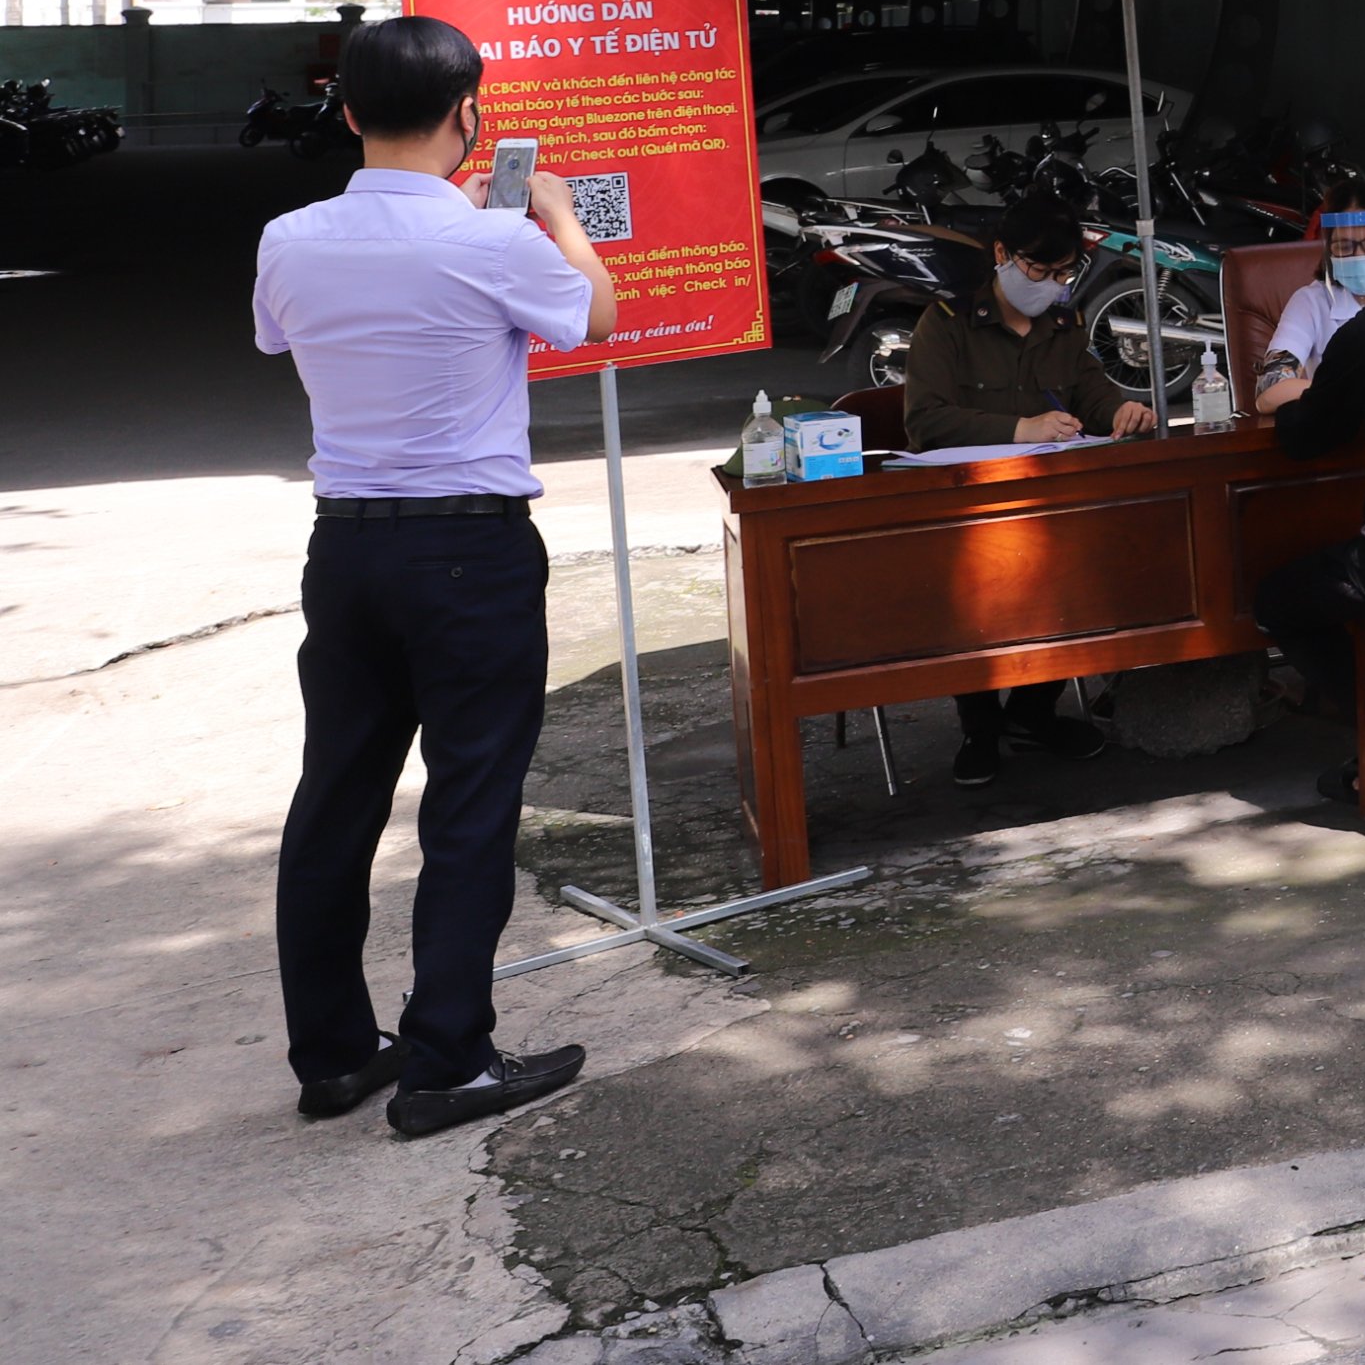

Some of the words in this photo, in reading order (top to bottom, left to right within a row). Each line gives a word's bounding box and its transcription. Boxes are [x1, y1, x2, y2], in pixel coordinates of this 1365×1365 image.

[507, 0, 595, 26] HƯỚNG
[510, 35, 562, 60] BÁO
[567, 37, 585, 56] Y
[591, 27, 622, 55] TẾ
[625, 29, 680, 57] ĐIỆN
[685, 23, 718, 49] TỬ
[490, 80, 541, 95] CBCNV
[543, 79, 561, 92] và
[563, 75, 606, 91] khách
[607, 72, 634, 87] đến
[636, 72, 659, 85] liên
[661, 71, 678, 85] hệ
[679, 69, 714, 83] công
[715, 67, 737, 80] tác
[493, 100, 524, 114] khai
[526, 97, 554, 111] báo
[555, 99, 564, 111] y
[565, 94, 580, 108] tế
[581, 94, 612, 107] theo
[613, 91, 641, 105] các
[642, 89, 676, 103] bước
[677, 89, 705, 101] sau:
[484, 120, 496, 132] 1:
[497, 116, 520, 131] Mở
[521, 114, 548, 131] ứng
[549, 114, 585, 128] dụng
[586, 111, 646, 125] Bluezone
[647, 107, 672, 121] trên
[673, 105, 702, 119] điện
[702, 102, 738, 117] thoại.
[539, 133, 564, 148] tiện
[566, 131, 591, 144] ích,
[593, 131, 617, 143] sau
[618, 125, 637, 139] đó
[638, 123, 669, 138] bấm
[670, 123, 707, 137] chọn:
[550, 150, 569, 164] in/
[571, 147, 616, 162] Check
[617, 146, 639, 158] out
[641, 142, 678, 157] (Quét
[679, 139, 701, 152] mã
[702, 137, 730, 151] QR).
[605, 252, 627, 266] mã
[628, 251, 645, 266] tại
[647, 245, 680, 262] điểm
[681, 243, 719, 258] thông
[719, 240, 749, 255] báo.
[624, 267, 654, 283] xuất
[655, 264, 684, 281] hiện
[686, 260, 723, 275] thông
[724, 257, 752, 271] báo
[648, 284, 677, 298] việc
[684, 277, 727, 293] Check
[734, 274, 752, 288] in/
[684, 314, 715, 334] ơn!
